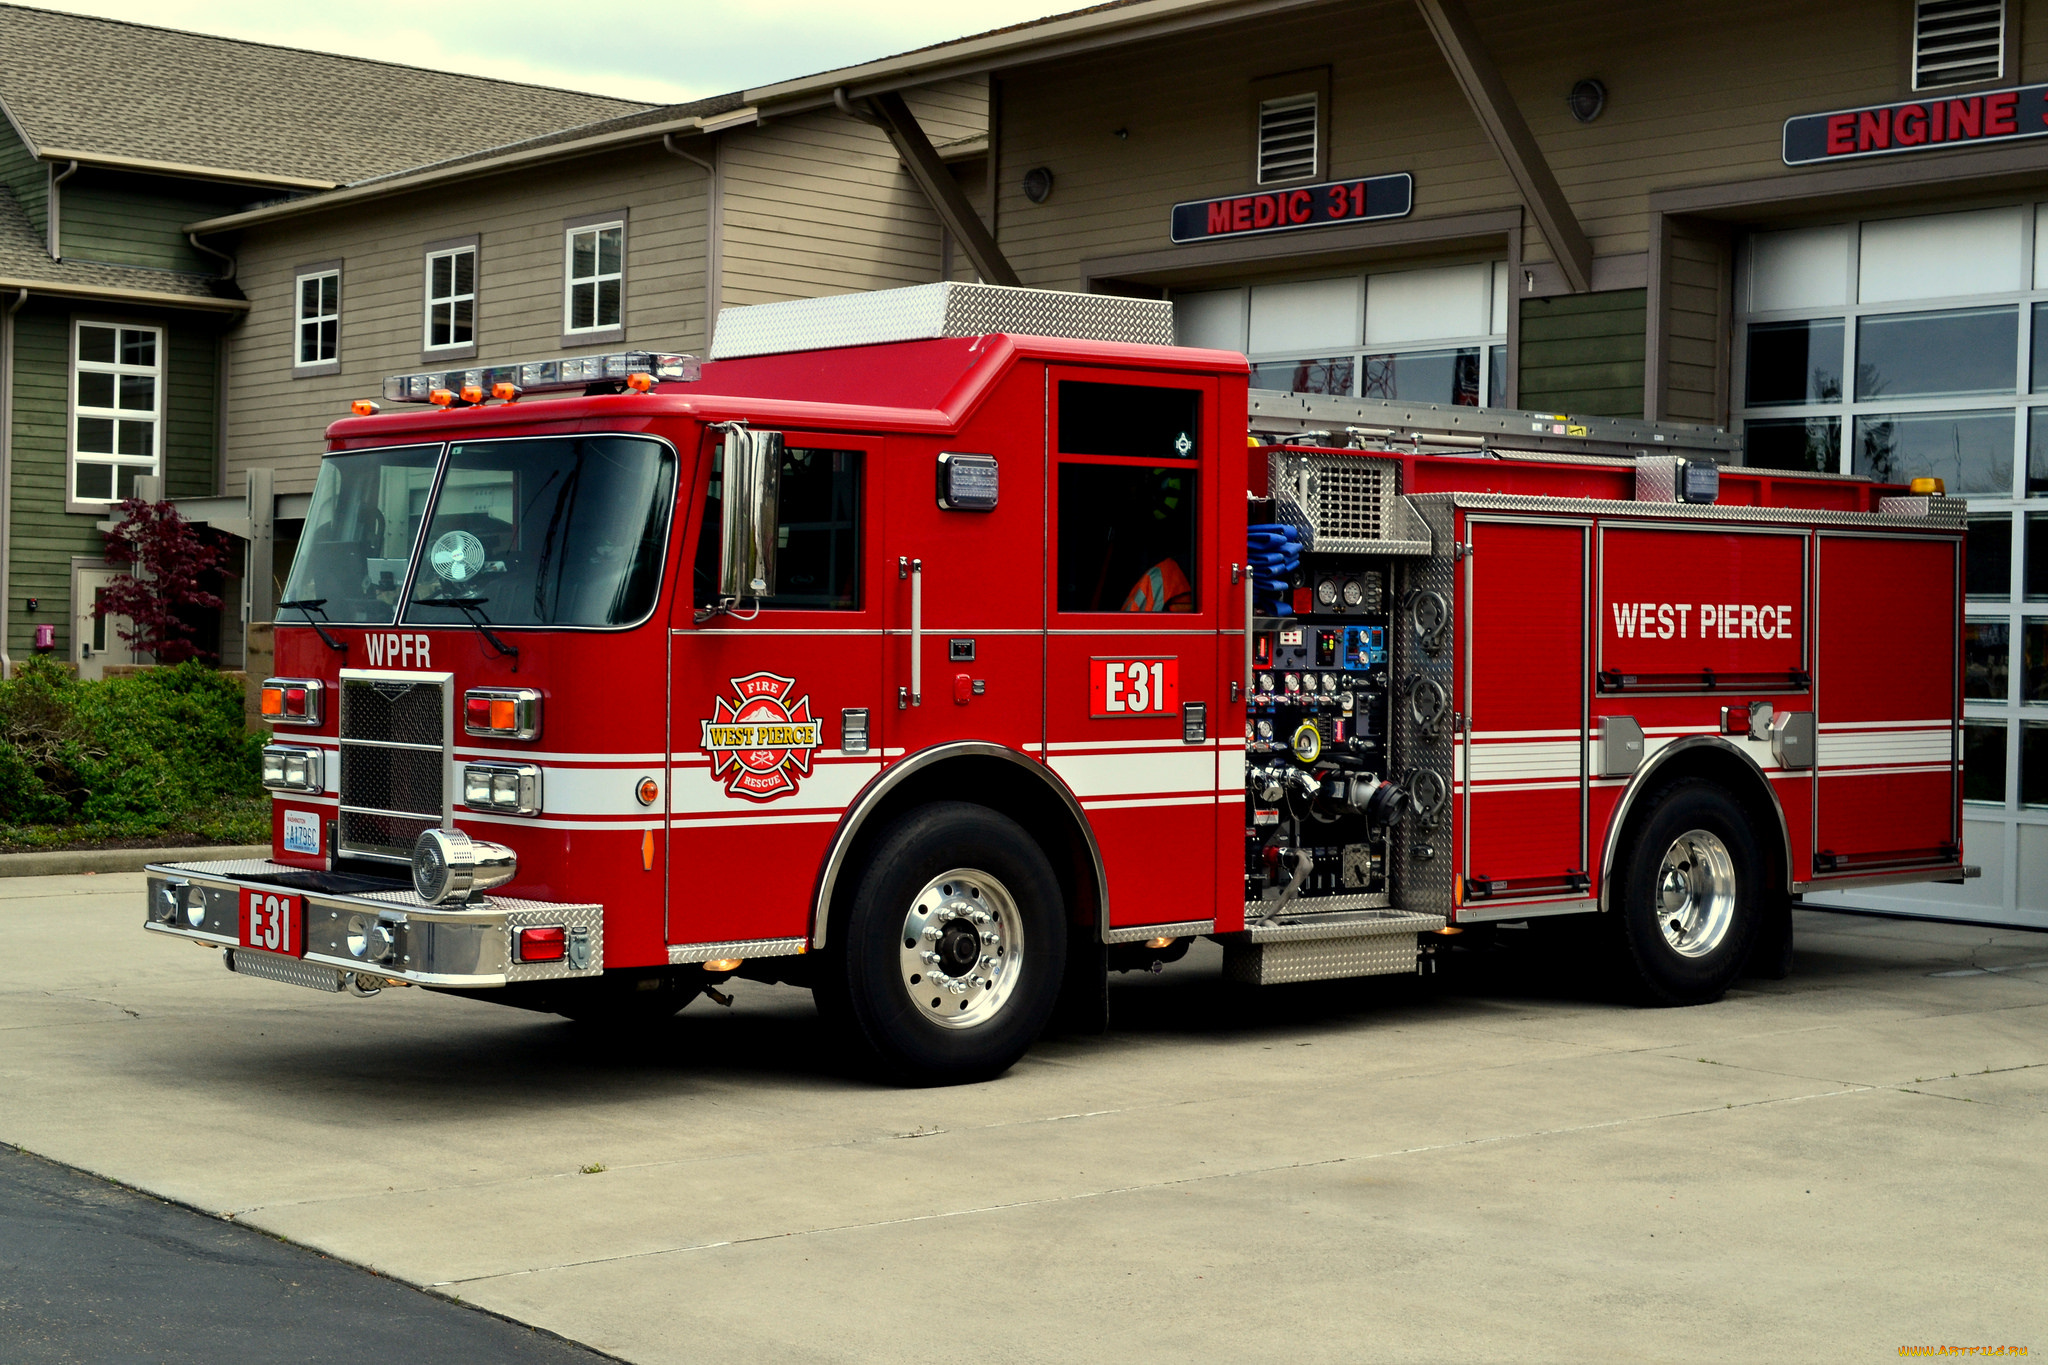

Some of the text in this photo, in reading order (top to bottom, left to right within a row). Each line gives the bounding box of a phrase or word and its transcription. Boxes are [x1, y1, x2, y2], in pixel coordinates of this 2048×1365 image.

[1826, 91, 2019, 155] ENGINE
[1207, 182, 1366, 234] MEDIC 31
[1612, 602, 1792, 640] WEST PIERCE
[365, 633, 431, 668] WPFR
[747, 681, 779, 694] FIRE
[1106, 662, 1163, 712] E31
[710, 726, 815, 746] WEST PIERCE
[744, 775, 781, 788] RESCUE
[290, 826, 317, 847] A1796C
[250, 892, 290, 952] E31
